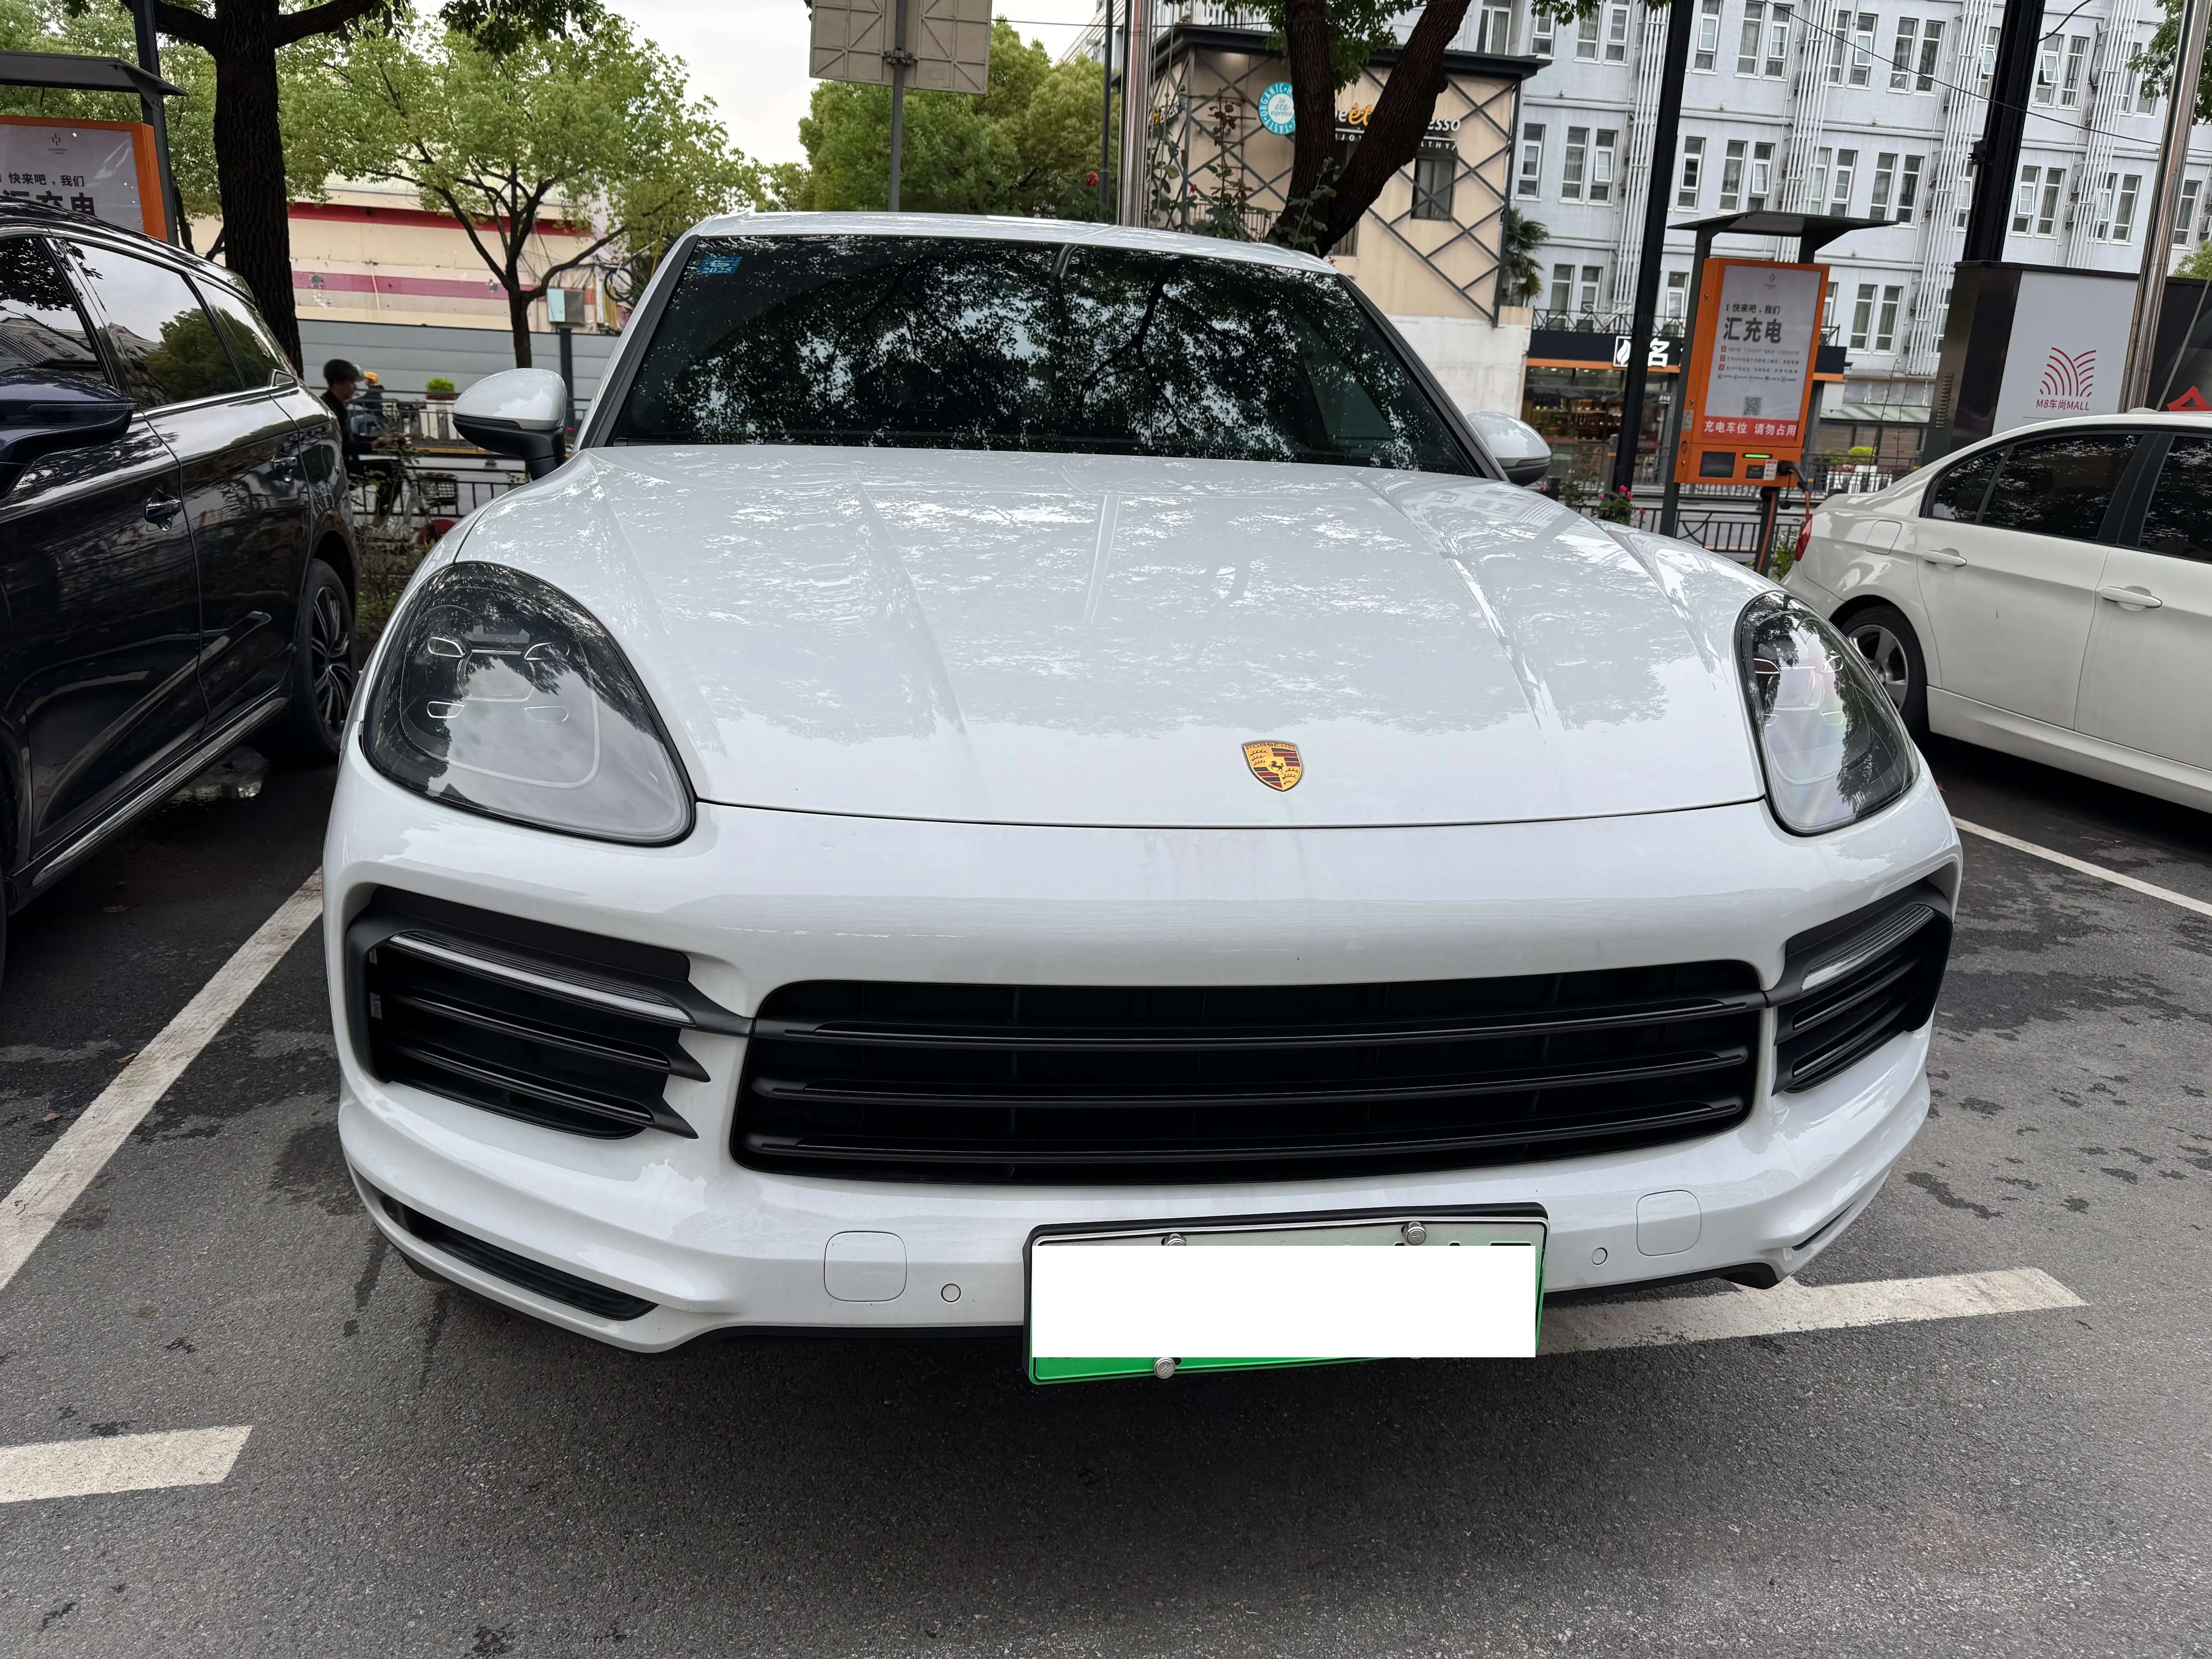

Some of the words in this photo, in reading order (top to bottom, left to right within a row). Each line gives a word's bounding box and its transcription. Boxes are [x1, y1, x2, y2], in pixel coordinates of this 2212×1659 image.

[1260, 84, 1283, 116] ORGANIC
[1348, 103, 1373, 126] ét
[1428, 117, 1460, 131] esso
[1723, 317, 1782, 343] 汇充电
[1647, 338, 1670, 368] 名
[2036, 399, 2089, 410] M8车尚MALL
[1704, 420, 1747, 434] 充电车位
[1754, 423, 1797, 436] 请勿占用
